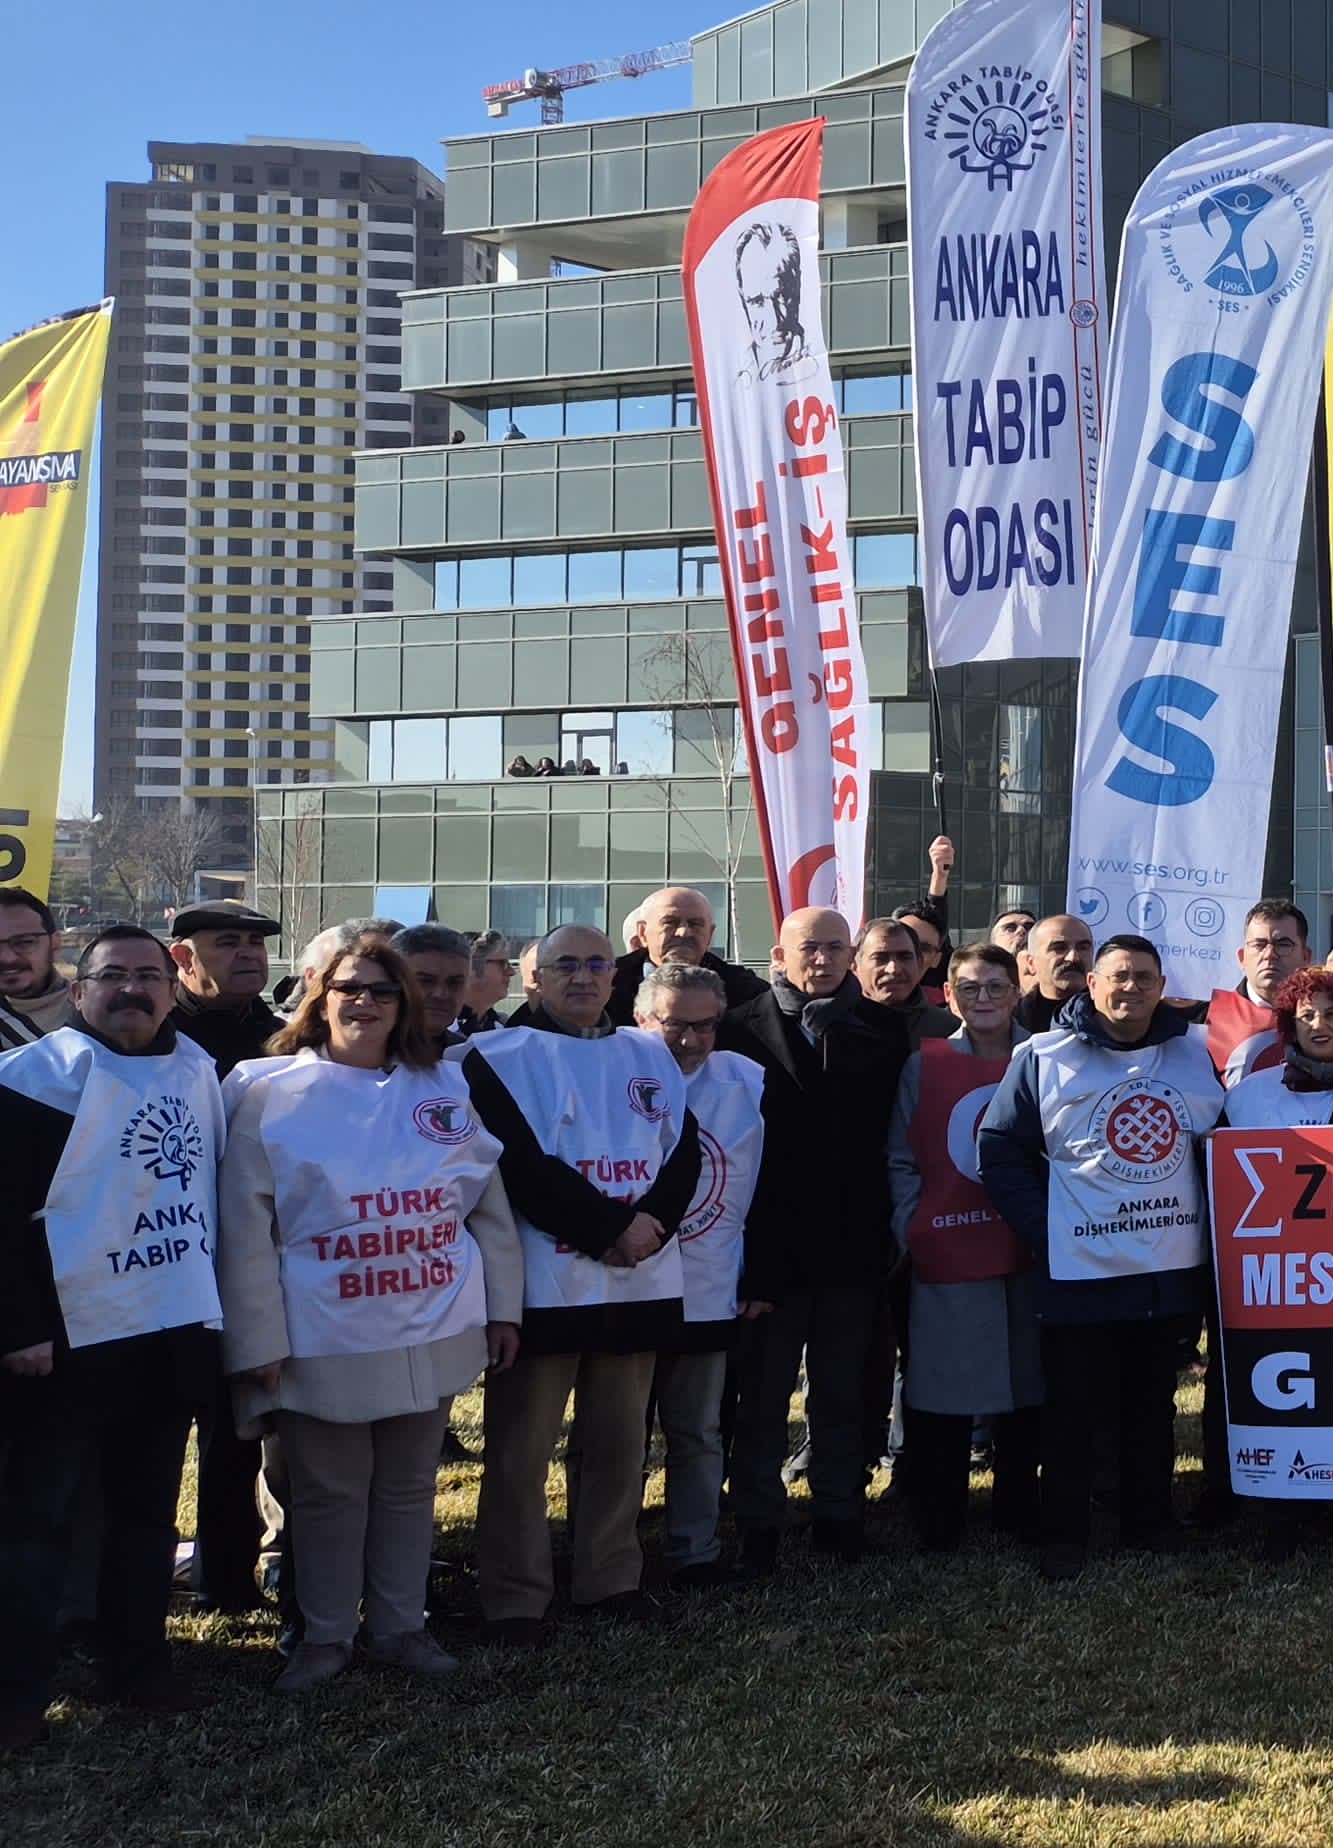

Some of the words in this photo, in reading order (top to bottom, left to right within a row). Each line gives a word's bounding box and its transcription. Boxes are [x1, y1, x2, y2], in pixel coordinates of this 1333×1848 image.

[924, 73, 973, 140] ANKARA
[979, 64, 1032, 82] TABİP
[934, 230, 1065, 322] ANKARA
[1218, 279, 1245, 293] 1996
[1217, 300, 1240, 312] SES
[936, 356, 1067, 468] TABİP
[944, 498, 1076, 597] ODASI
[1104, 351, 1260, 806] SES
[734, 480, 799, 755] GENEL
[778, 395, 859, 822] SAĞLIK-İŞ
[1078, 857, 1230, 887] www.ses.org.tr
[120, 1102, 156, 1159] ANKARA
[576, 1155, 652, 1183] TÜRK
[351, 1187, 445, 1220] TÜRK
[932, 1209, 992, 1228] GENEL
[1118, 1196, 1180, 1215] ANKARA
[311, 1219, 458, 1261] TABİPLERİ
[1074, 1212, 1175, 1239] DİŞHEKİMLERİ
[107, 1237, 190, 1274] TABİP
[339, 1253, 455, 1300] BİRLİĞİ
